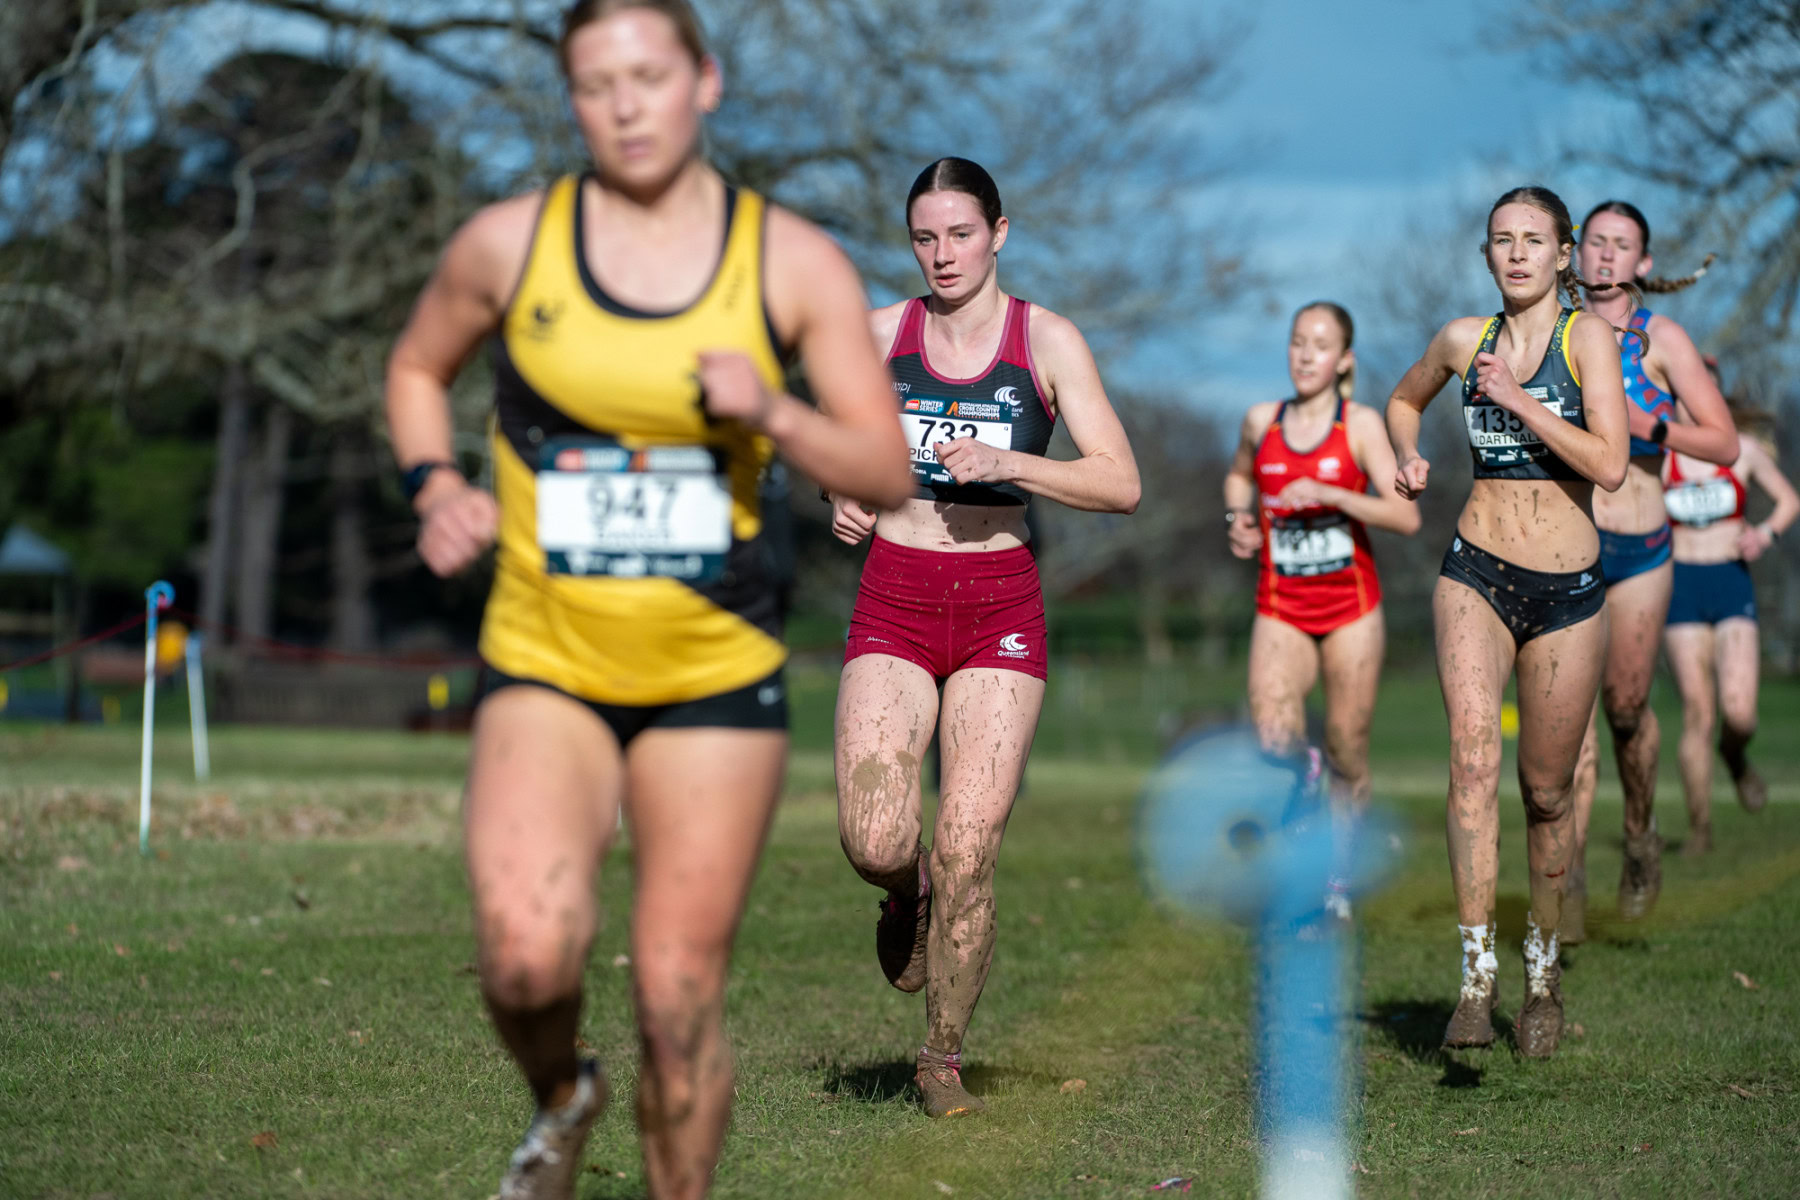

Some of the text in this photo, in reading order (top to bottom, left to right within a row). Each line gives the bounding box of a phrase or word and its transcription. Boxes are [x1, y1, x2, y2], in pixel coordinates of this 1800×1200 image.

[919, 404, 938, 413] SERIES
[920, 399, 943, 408] WINTER
[1479, 432, 1541, 446] DARTNAL
[587, 476, 677, 522] 947
